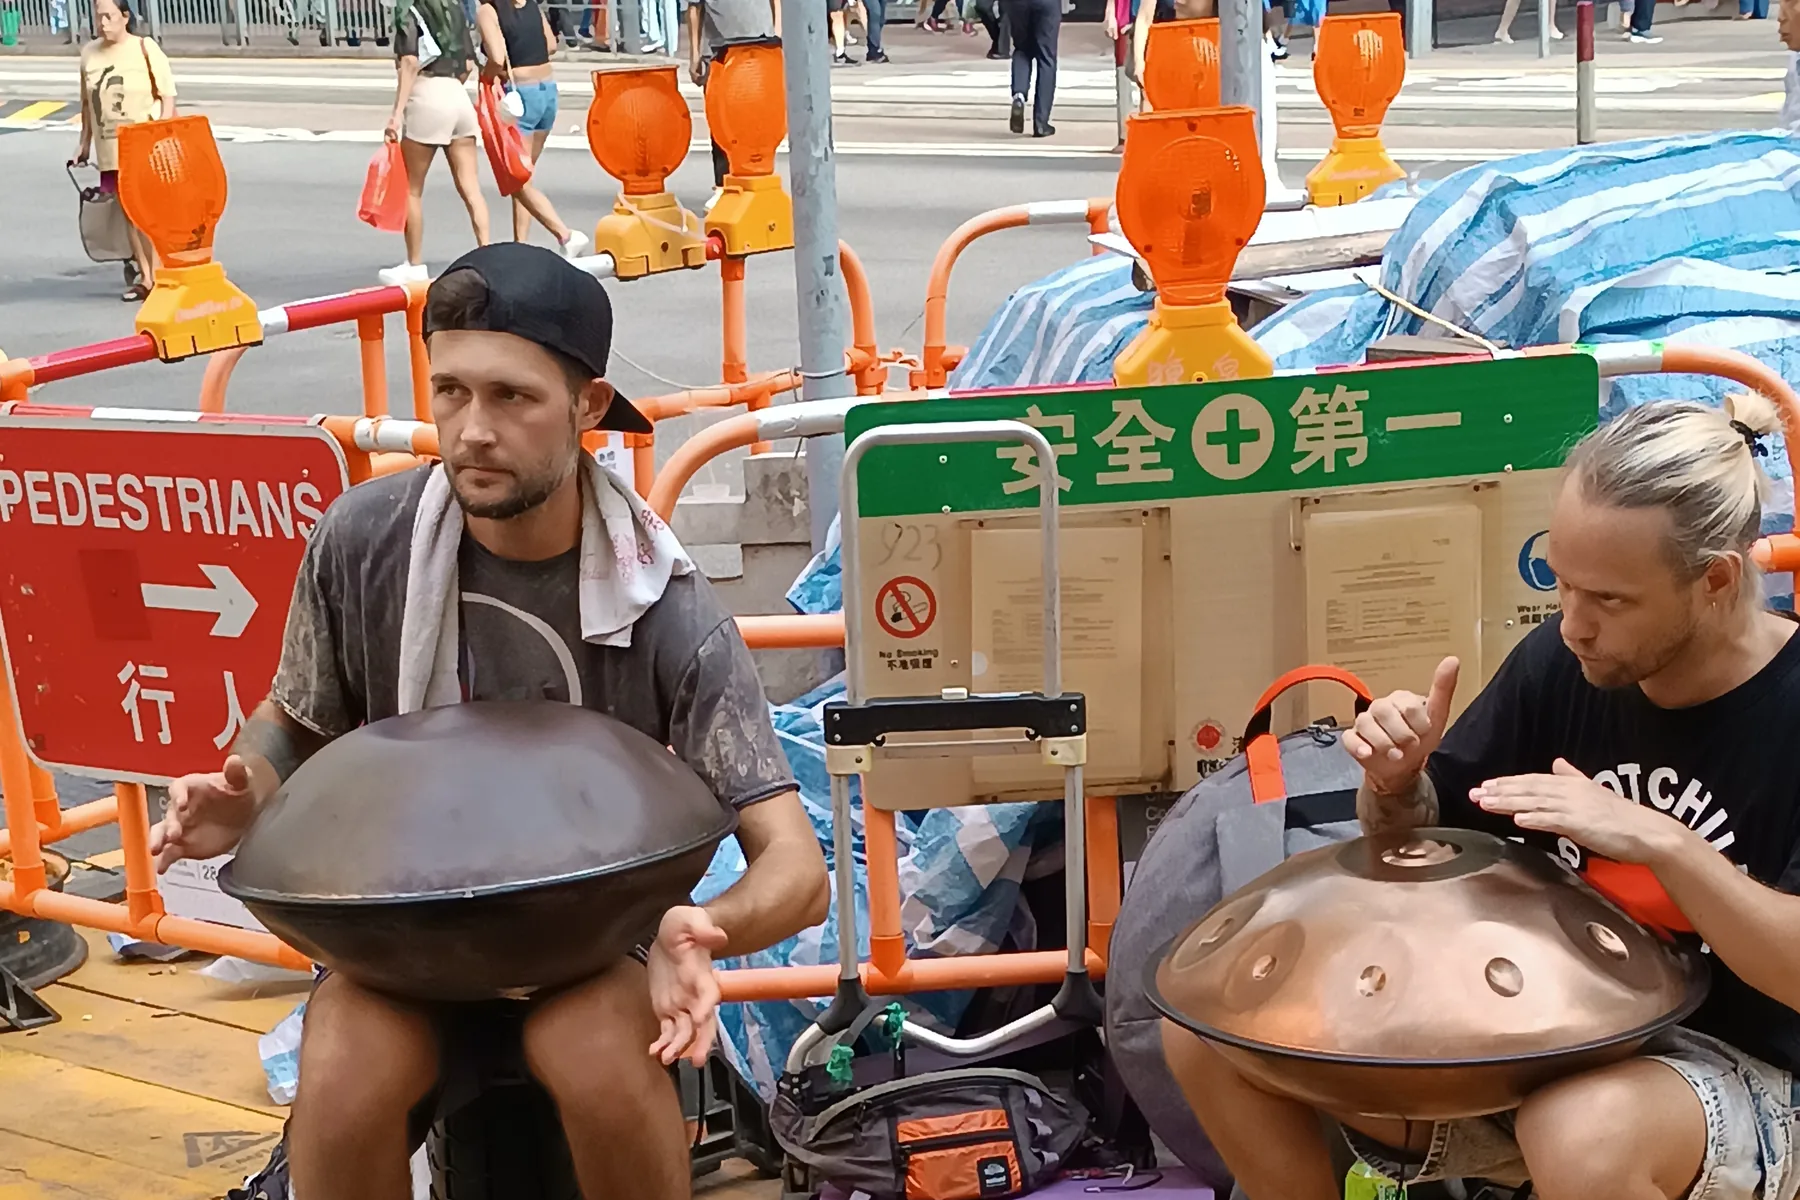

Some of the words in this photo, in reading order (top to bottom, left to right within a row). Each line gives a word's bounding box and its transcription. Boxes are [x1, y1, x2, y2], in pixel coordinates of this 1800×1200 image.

[996, 399, 1175, 494] 安全
[1289, 384, 1462, 474] 第一
[0, 470, 323, 540] PEDESTRIANS
